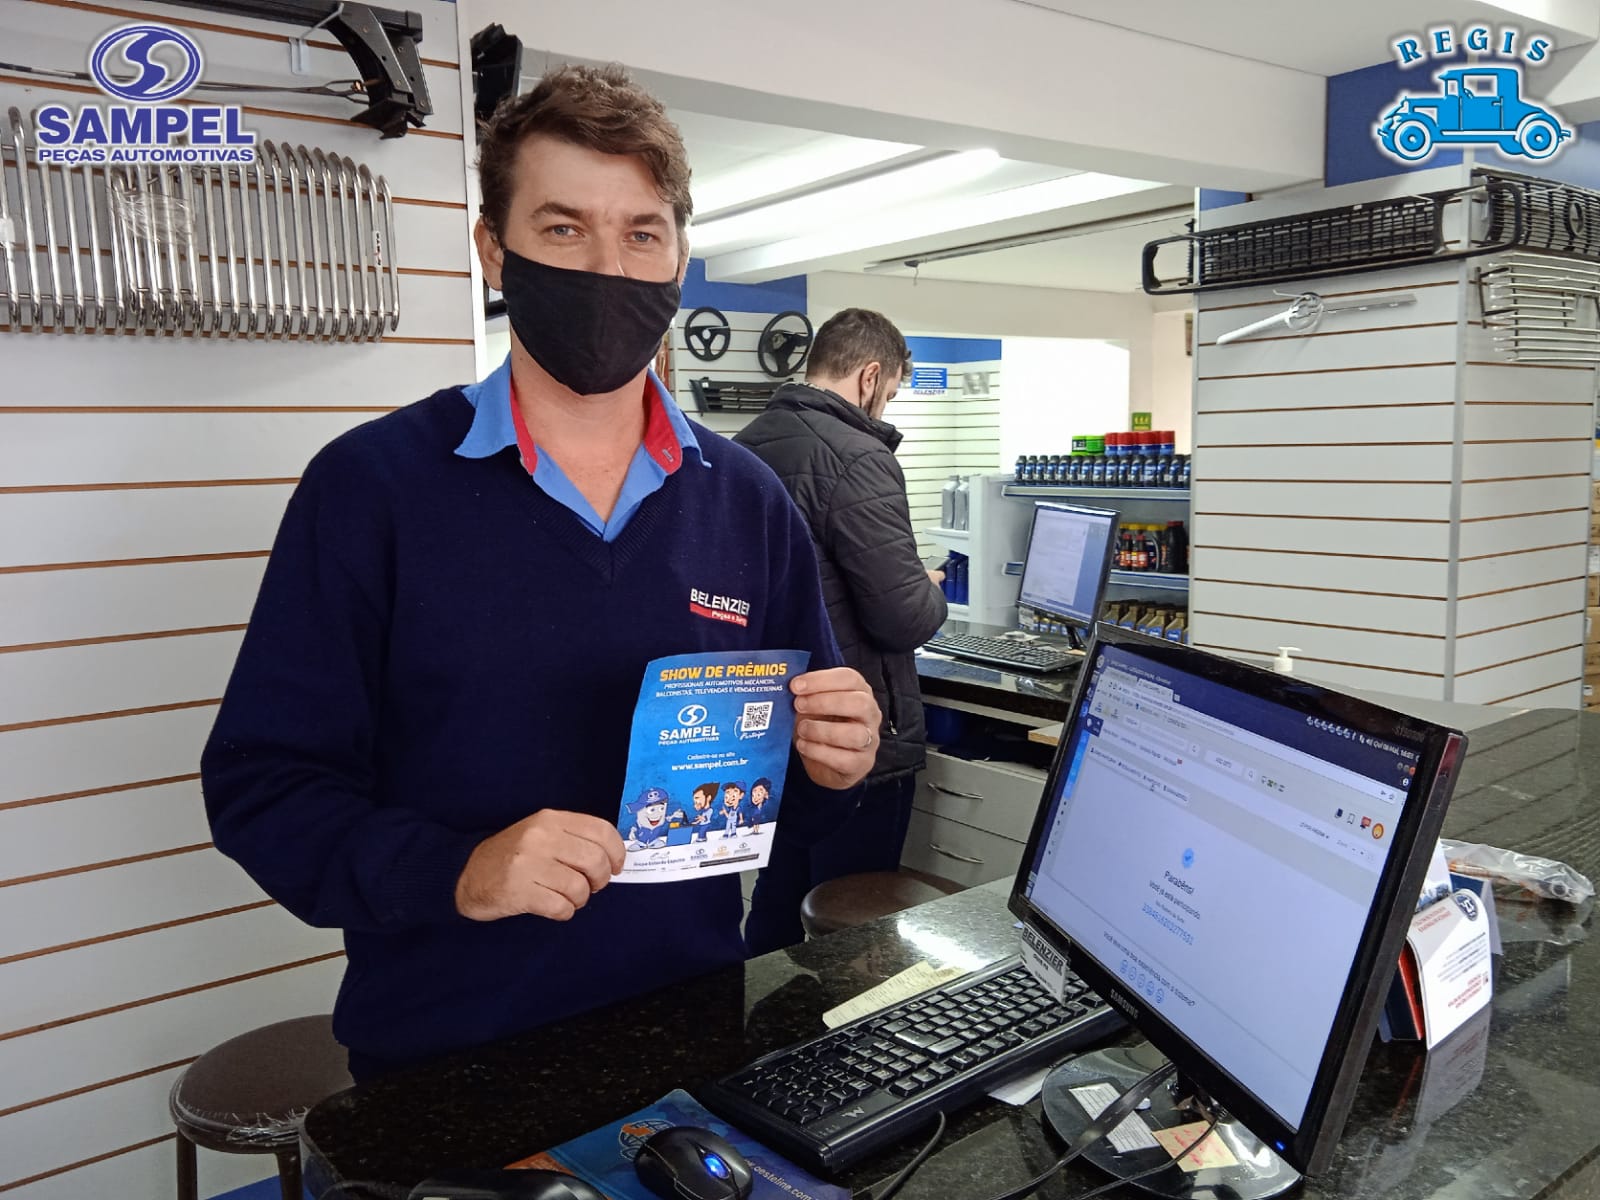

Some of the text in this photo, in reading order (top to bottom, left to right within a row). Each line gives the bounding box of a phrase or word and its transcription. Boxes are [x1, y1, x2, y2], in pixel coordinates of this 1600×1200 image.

[660, 661, 788, 682] SHOW DE PRÊMIOS
[664, 681, 704, 690] PROFISSIONAIS
[705, 679, 743, 687] AUTOMOTIVOS
[756, 685, 784, 693] EXTERNAS
[659, 725, 720, 741] SAMPEL
[671, 758, 749, 771] www.sampel.com.br
[1022, 926, 1065, 975] BELENZIER
